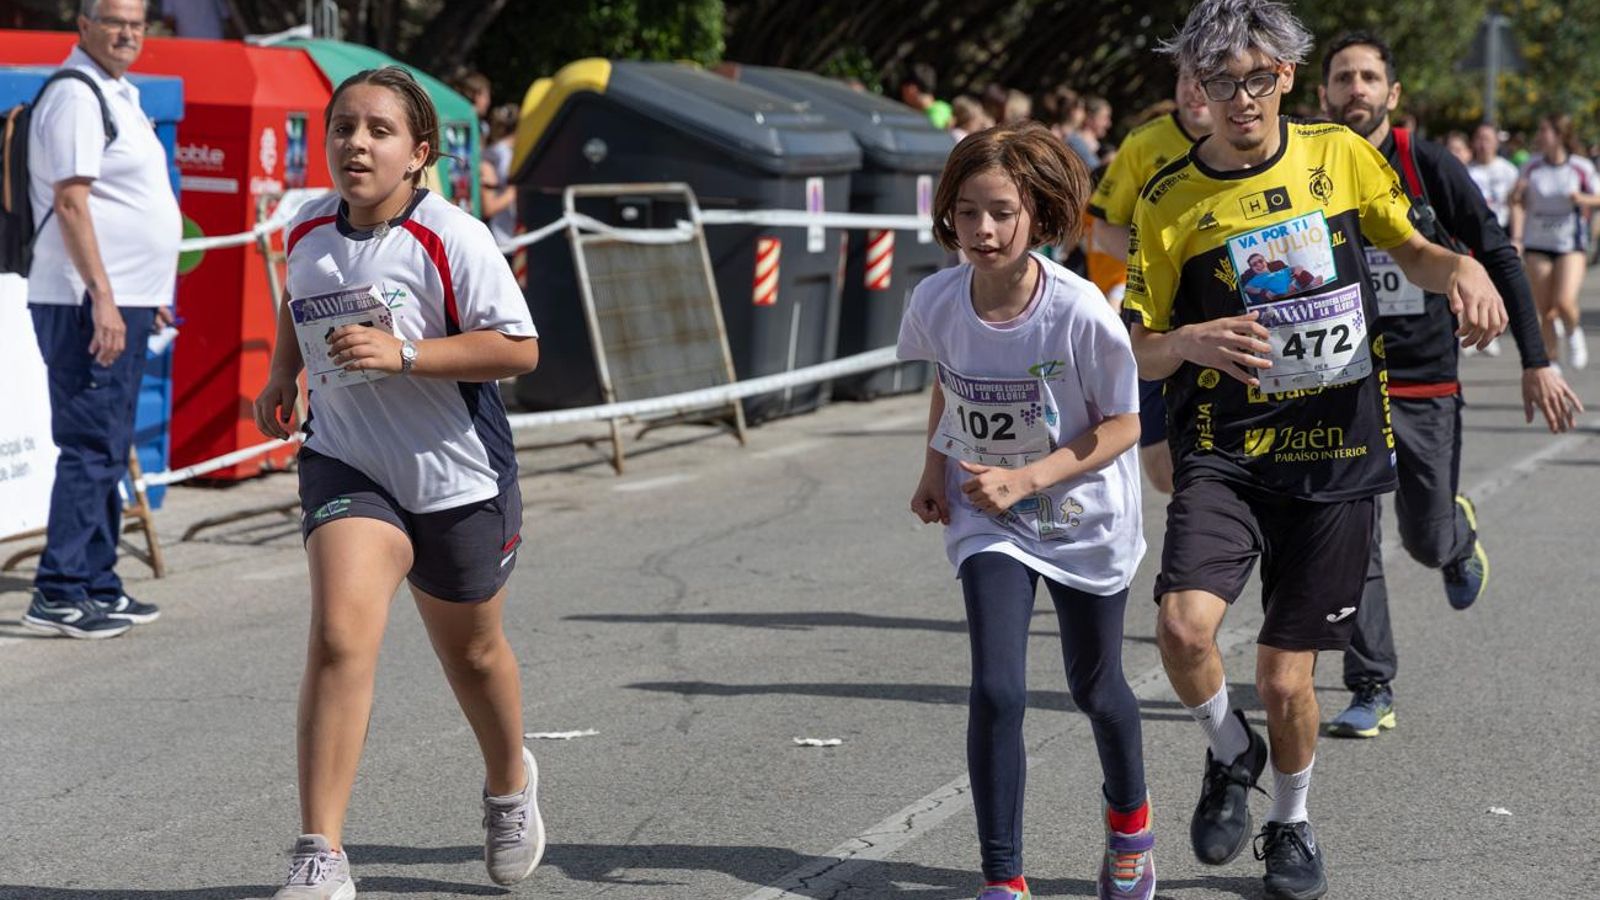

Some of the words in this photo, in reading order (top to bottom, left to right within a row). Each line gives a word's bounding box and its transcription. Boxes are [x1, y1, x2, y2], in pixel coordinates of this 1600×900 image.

[1238, 236, 1257, 249] VA
[1262, 226, 1289, 242] POR
[1291, 218, 1309, 231] TI
[1267, 227, 1323, 260] JULIO
[1332, 231, 1347, 247] AL
[1370, 271, 1399, 292] 50
[1282, 324, 1352, 360] 472
[981, 392, 991, 400] LA
[996, 391, 1027, 400] GLORIA
[957, 404, 1016, 440] 102
[1276, 420, 1344, 450] Jaén
[1275, 450, 1319, 463] PARAÍSO
[1321, 445, 1368, 460] INTERIOR
